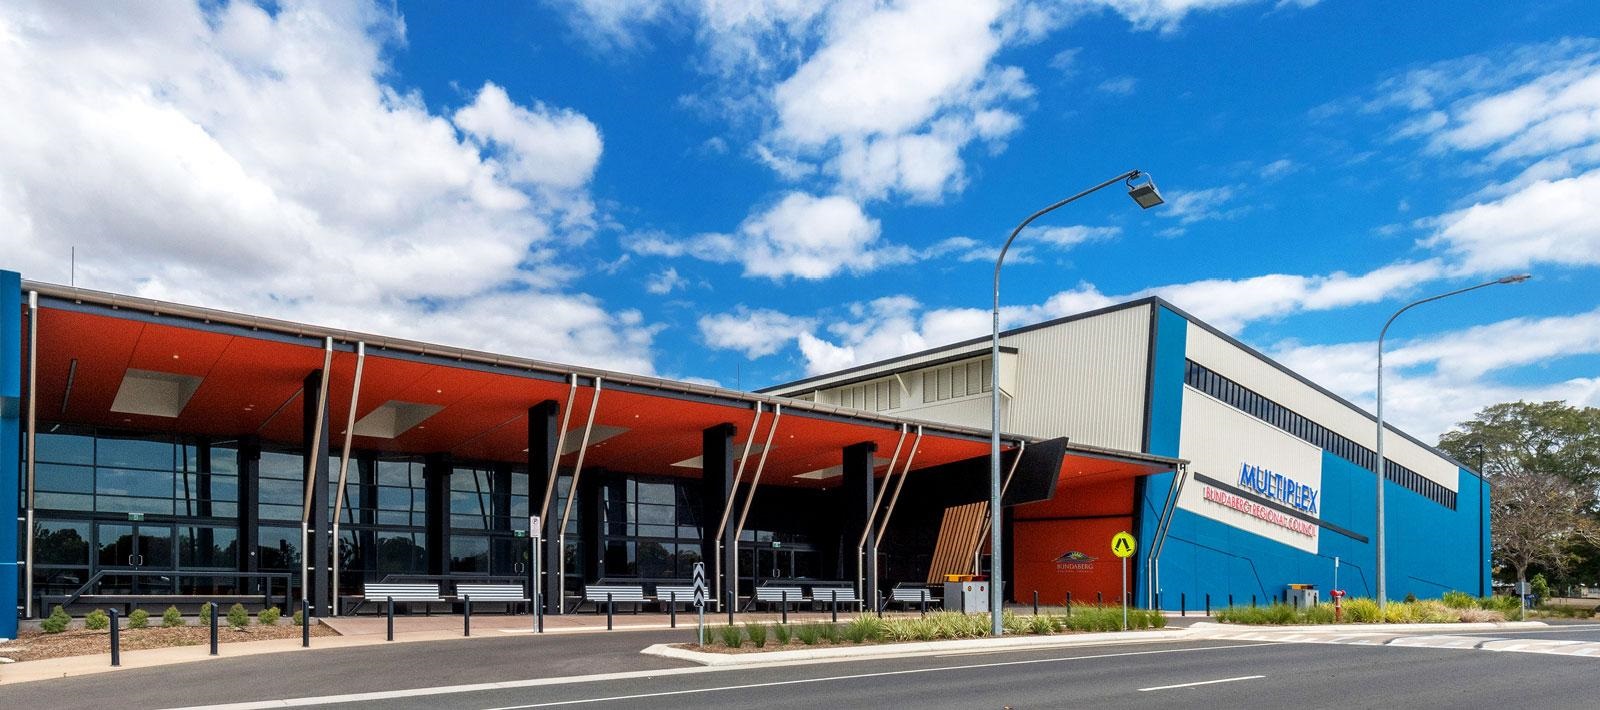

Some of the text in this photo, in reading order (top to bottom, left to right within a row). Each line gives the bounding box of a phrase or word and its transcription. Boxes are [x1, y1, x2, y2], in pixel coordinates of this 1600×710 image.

[1205, 487, 1316, 537] BUNDABERG REGIONAL COUNCIL
[1239, 462, 1318, 513] MULTIPLEX
